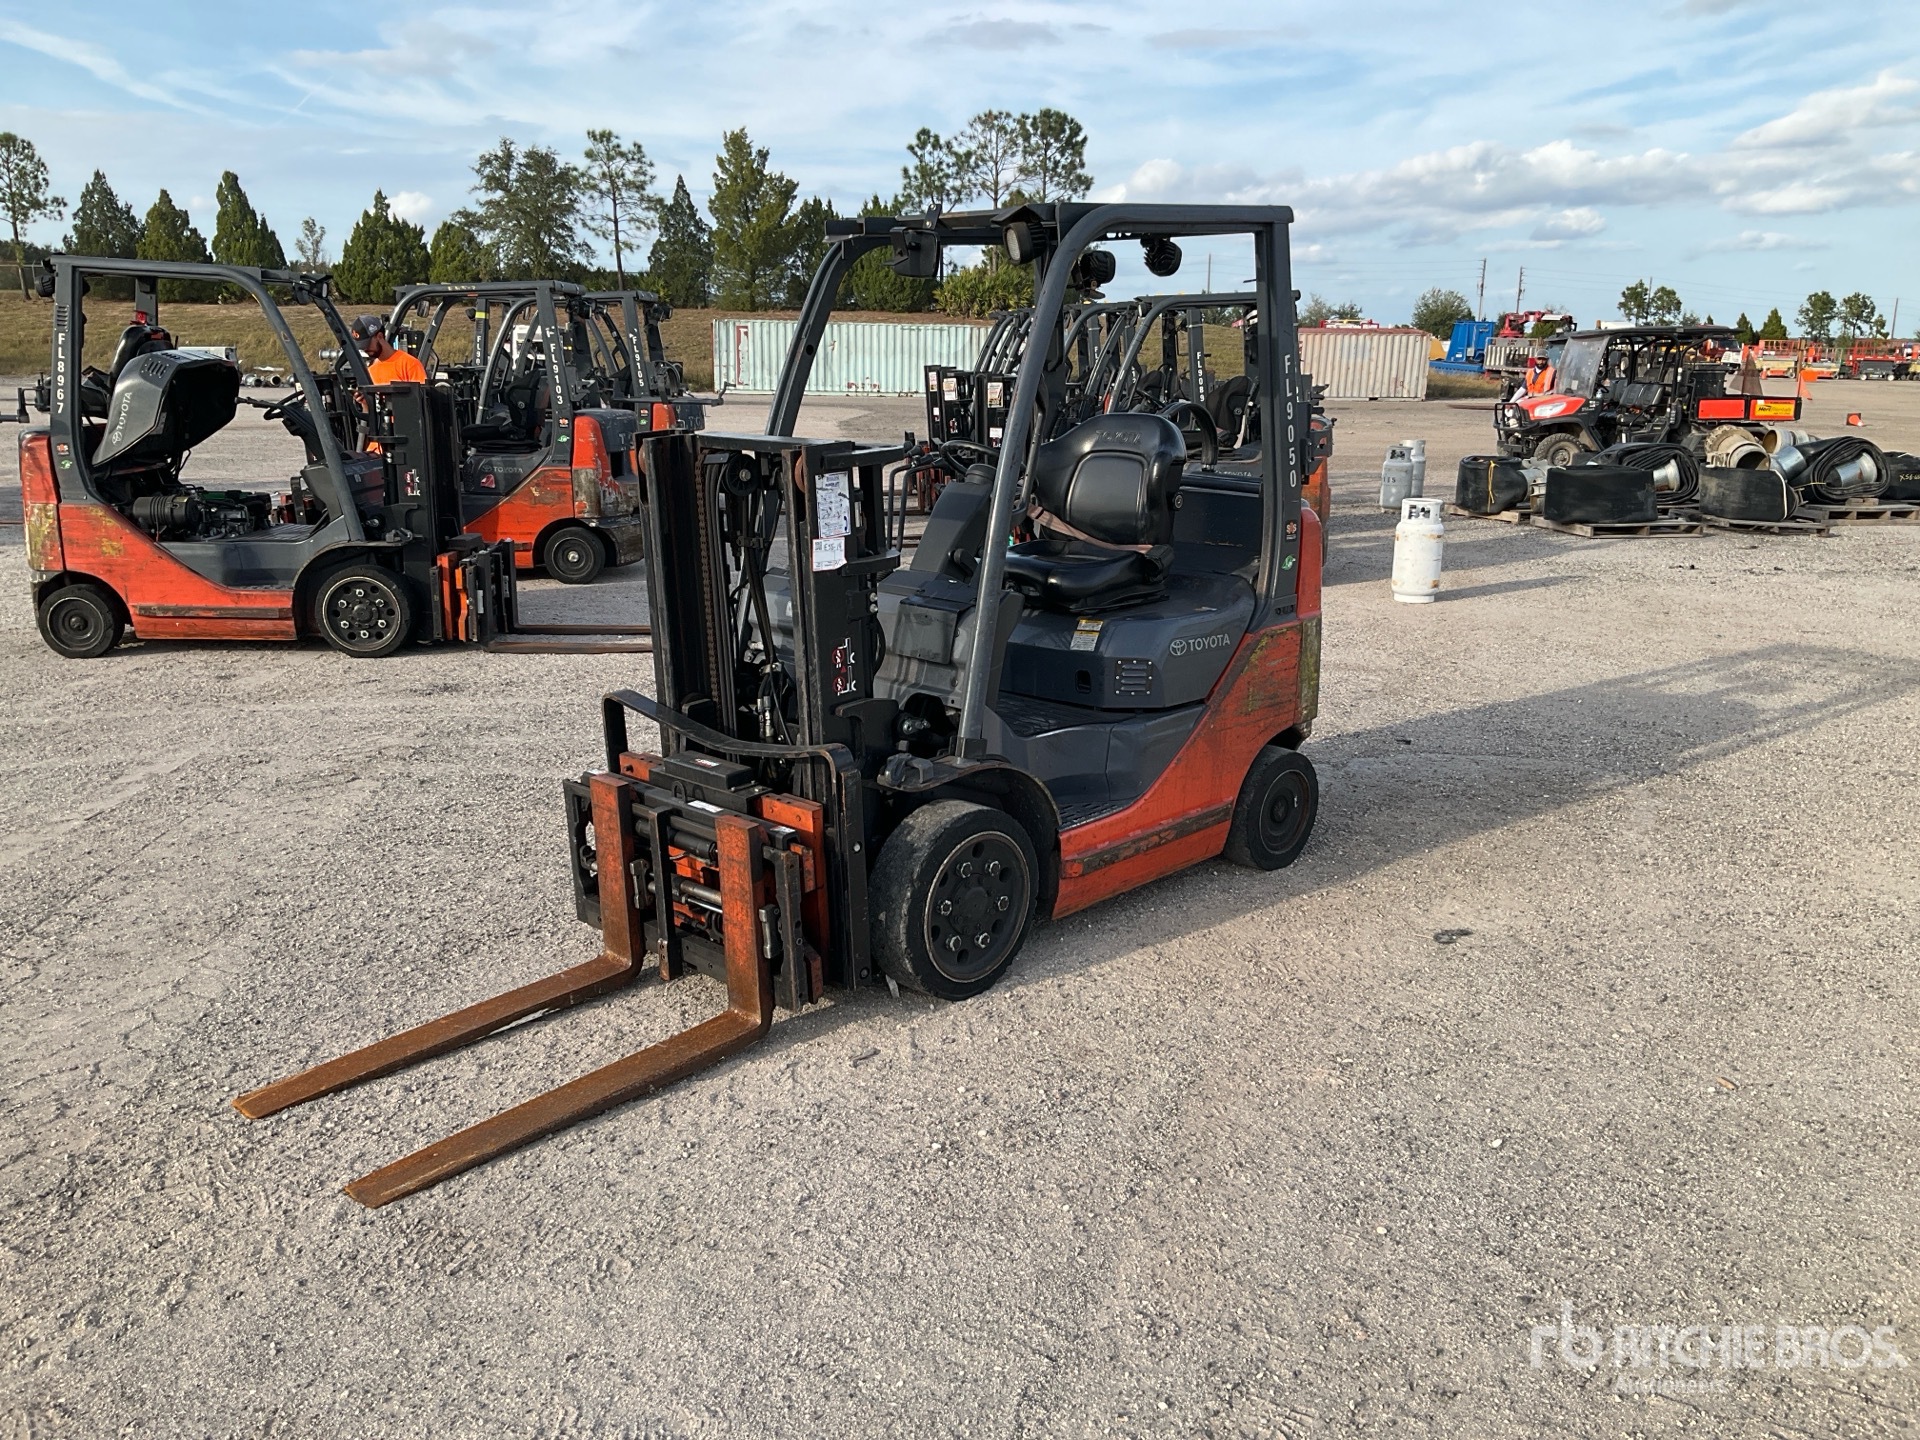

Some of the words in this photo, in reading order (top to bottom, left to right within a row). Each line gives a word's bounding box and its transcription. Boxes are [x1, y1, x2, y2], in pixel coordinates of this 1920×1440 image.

[56, 332, 66, 414] FL8967
[549, 343, 564, 406] FL9103
[631, 336, 645, 388] FL9105
[1196, 351, 1205, 402] FL9089
[117, 391, 133, 431] TOYOTA
[1284, 354, 1298, 489] FL9050
[493, 466, 524, 475] TOYOTA
[1188, 633, 1231, 652] TOYOTA
